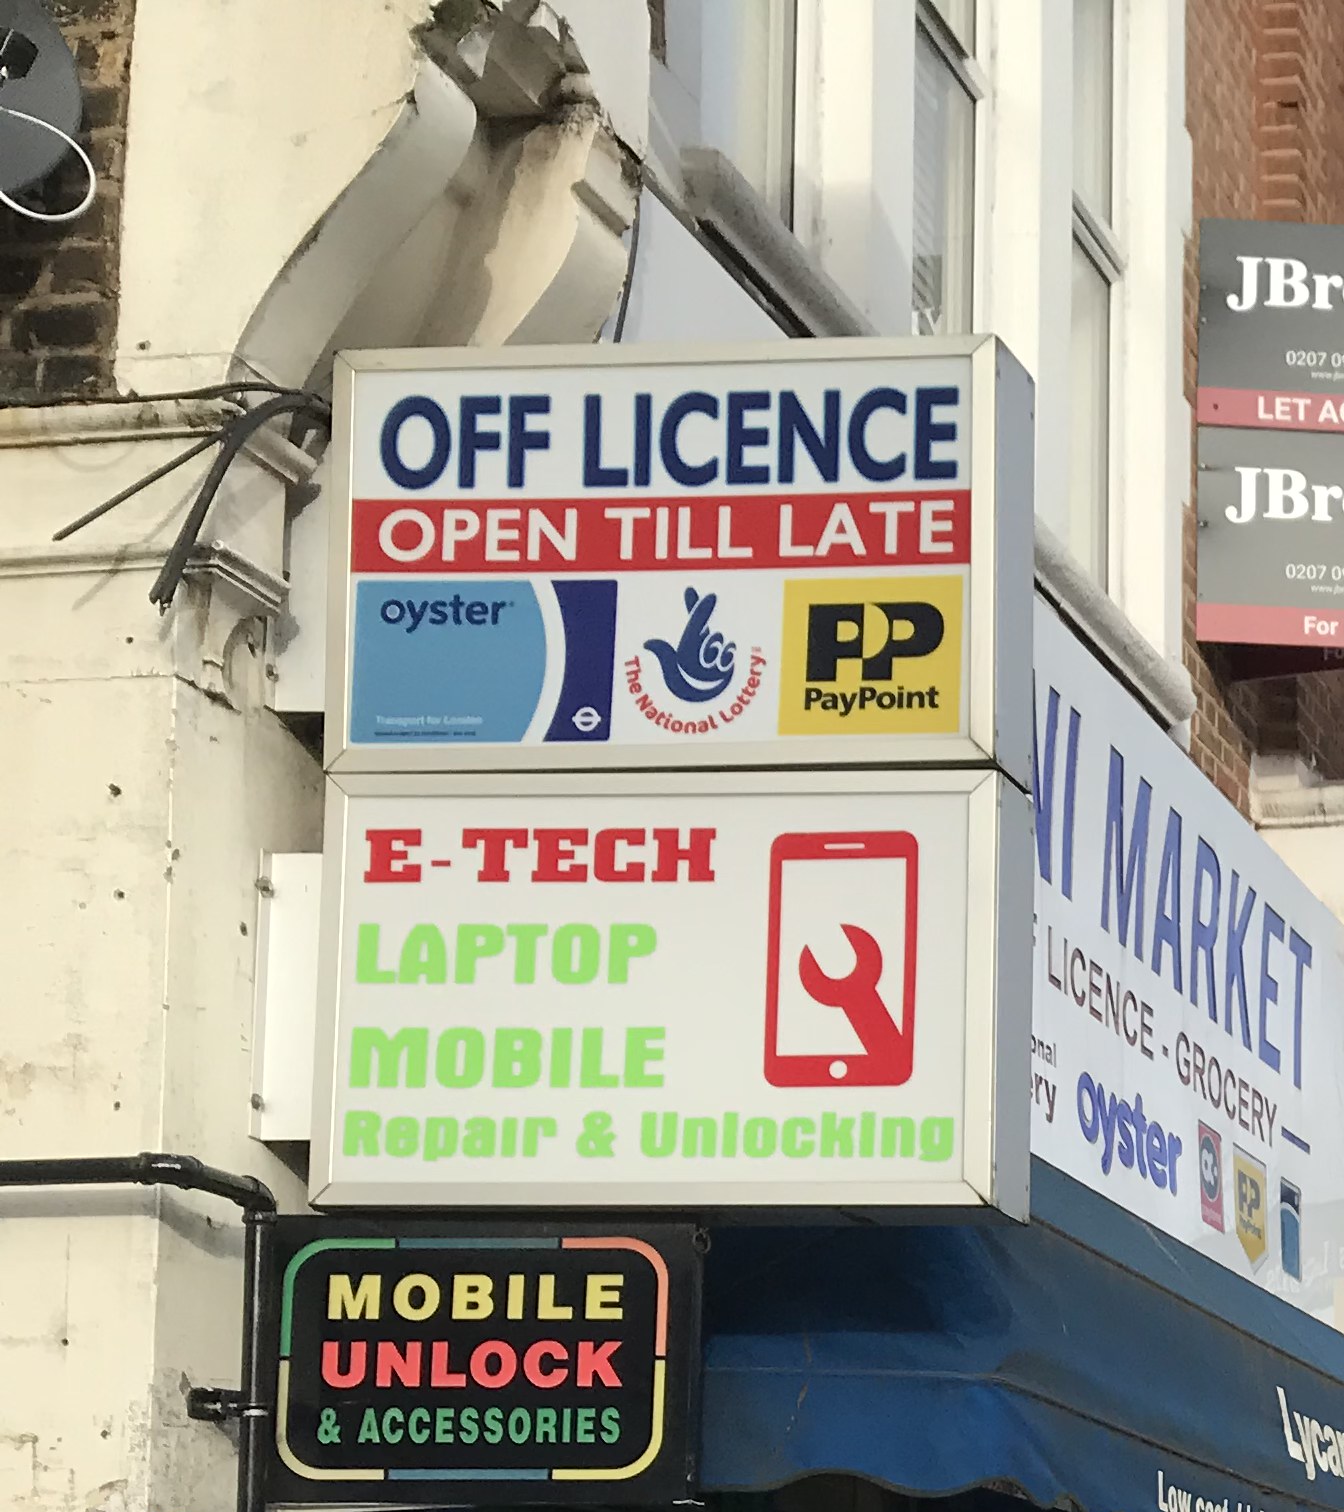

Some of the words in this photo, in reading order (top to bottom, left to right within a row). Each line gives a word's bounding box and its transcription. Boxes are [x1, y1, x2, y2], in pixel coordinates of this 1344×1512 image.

[1285, 350, 1327, 368] 0207
[1257, 395, 1311, 421] LET
[380, 394, 551, 490] OFF
[583, 386, 960, 488] LICENCE
[378, 508, 578, 563] OPEN
[604, 505, 752, 560] TILL
[779, 500, 955, 558] LATE
[1285, 564, 1327, 580] 0207
[380, 595, 506, 633] oyster
[1304, 616, 1338, 635] For
[624, 656, 641, 686] The
[638, 684, 718, 734] National
[717, 650, 768, 724] Lottery
[804, 685, 940, 718] PayPoint
[364, 827, 717, 883] E-TECH
[1101, 744, 1312, 1090] MARKET
[356, 922, 658, 985] LAPTOP
[349, 1027, 666, 1088] MOBILE
[1047, 924, 1154, 1061] LICENCE
[1175, 1032, 1280, 1149] GROCERY
[342, 1111, 558, 1162] Repair
[576, 1112, 616, 1158] &
[640, 1111, 955, 1162] Unlocking
[1076, 1071, 1183, 1196] oyster
[327, 1273, 625, 1321] MOBILE
[320, 1340, 623, 1389] UNLOCK
[317, 1408, 341, 1444] &
[357, 1407, 621, 1445] ACCESSORIES
